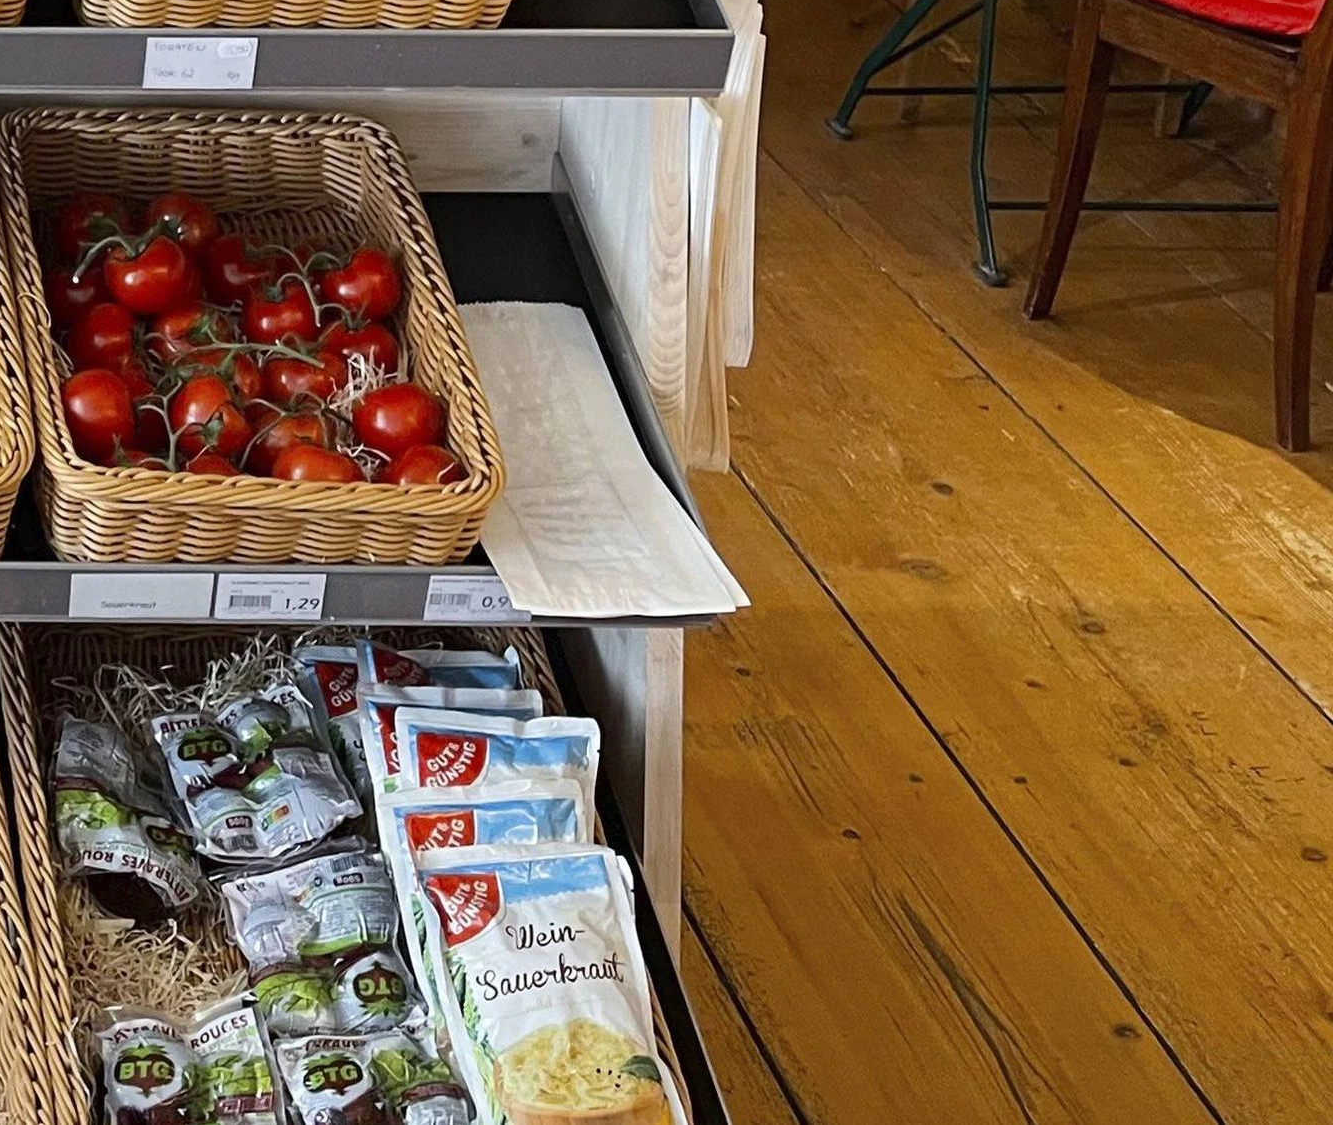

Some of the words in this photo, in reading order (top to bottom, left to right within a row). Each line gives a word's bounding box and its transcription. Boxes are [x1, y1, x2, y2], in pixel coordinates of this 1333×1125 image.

[284, 597, 321, 611] 1,29
[481, 596, 512, 609] 0,9
[182, 739, 227, 756] BTG
[505, 921, 587, 951] Wein-
[476, 951, 626, 1001] Sauerkraut
[189, 1013, 249, 1049] ROUGES
[118, 1060, 175, 1081] BTG
[308, 1063, 357, 1091] BTG
